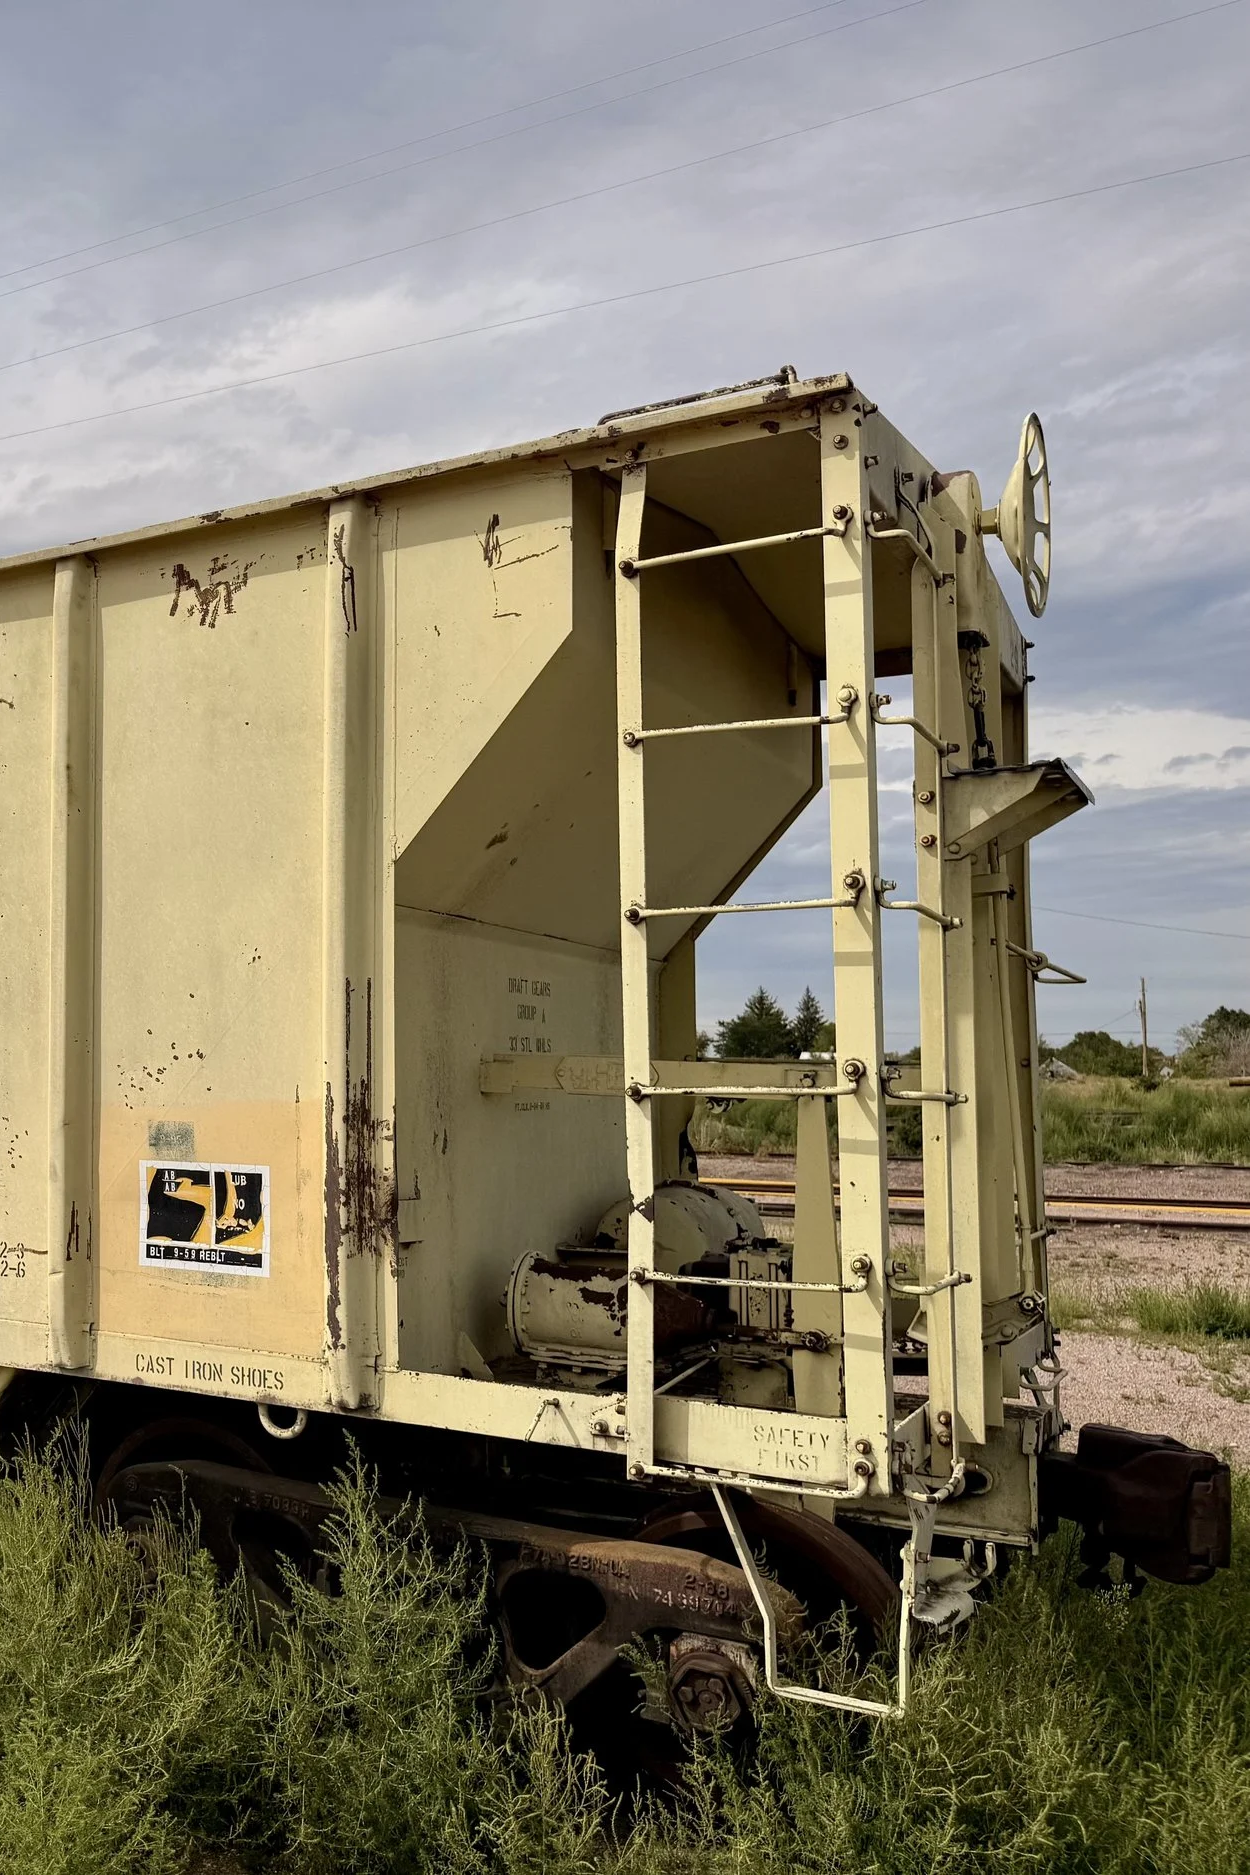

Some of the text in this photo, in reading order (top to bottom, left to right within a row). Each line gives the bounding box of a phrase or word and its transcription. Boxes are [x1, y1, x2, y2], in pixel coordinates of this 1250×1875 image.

[508, 977, 551, 998] DRAFT GEARS
[517, 1004, 546, 1024] GROUP A
[520, 1037, 532, 1053] STL
[150, 1246, 165, 1259] BLT
[199, 1250, 226, 1263] REBLT
[135, 1353, 285, 1391] CAST IRON SHOES
[753, 1424, 830, 1449] SAFETY
[757, 1448, 822, 1473] FIRST
[684, 1573, 730, 1599] 2-68
